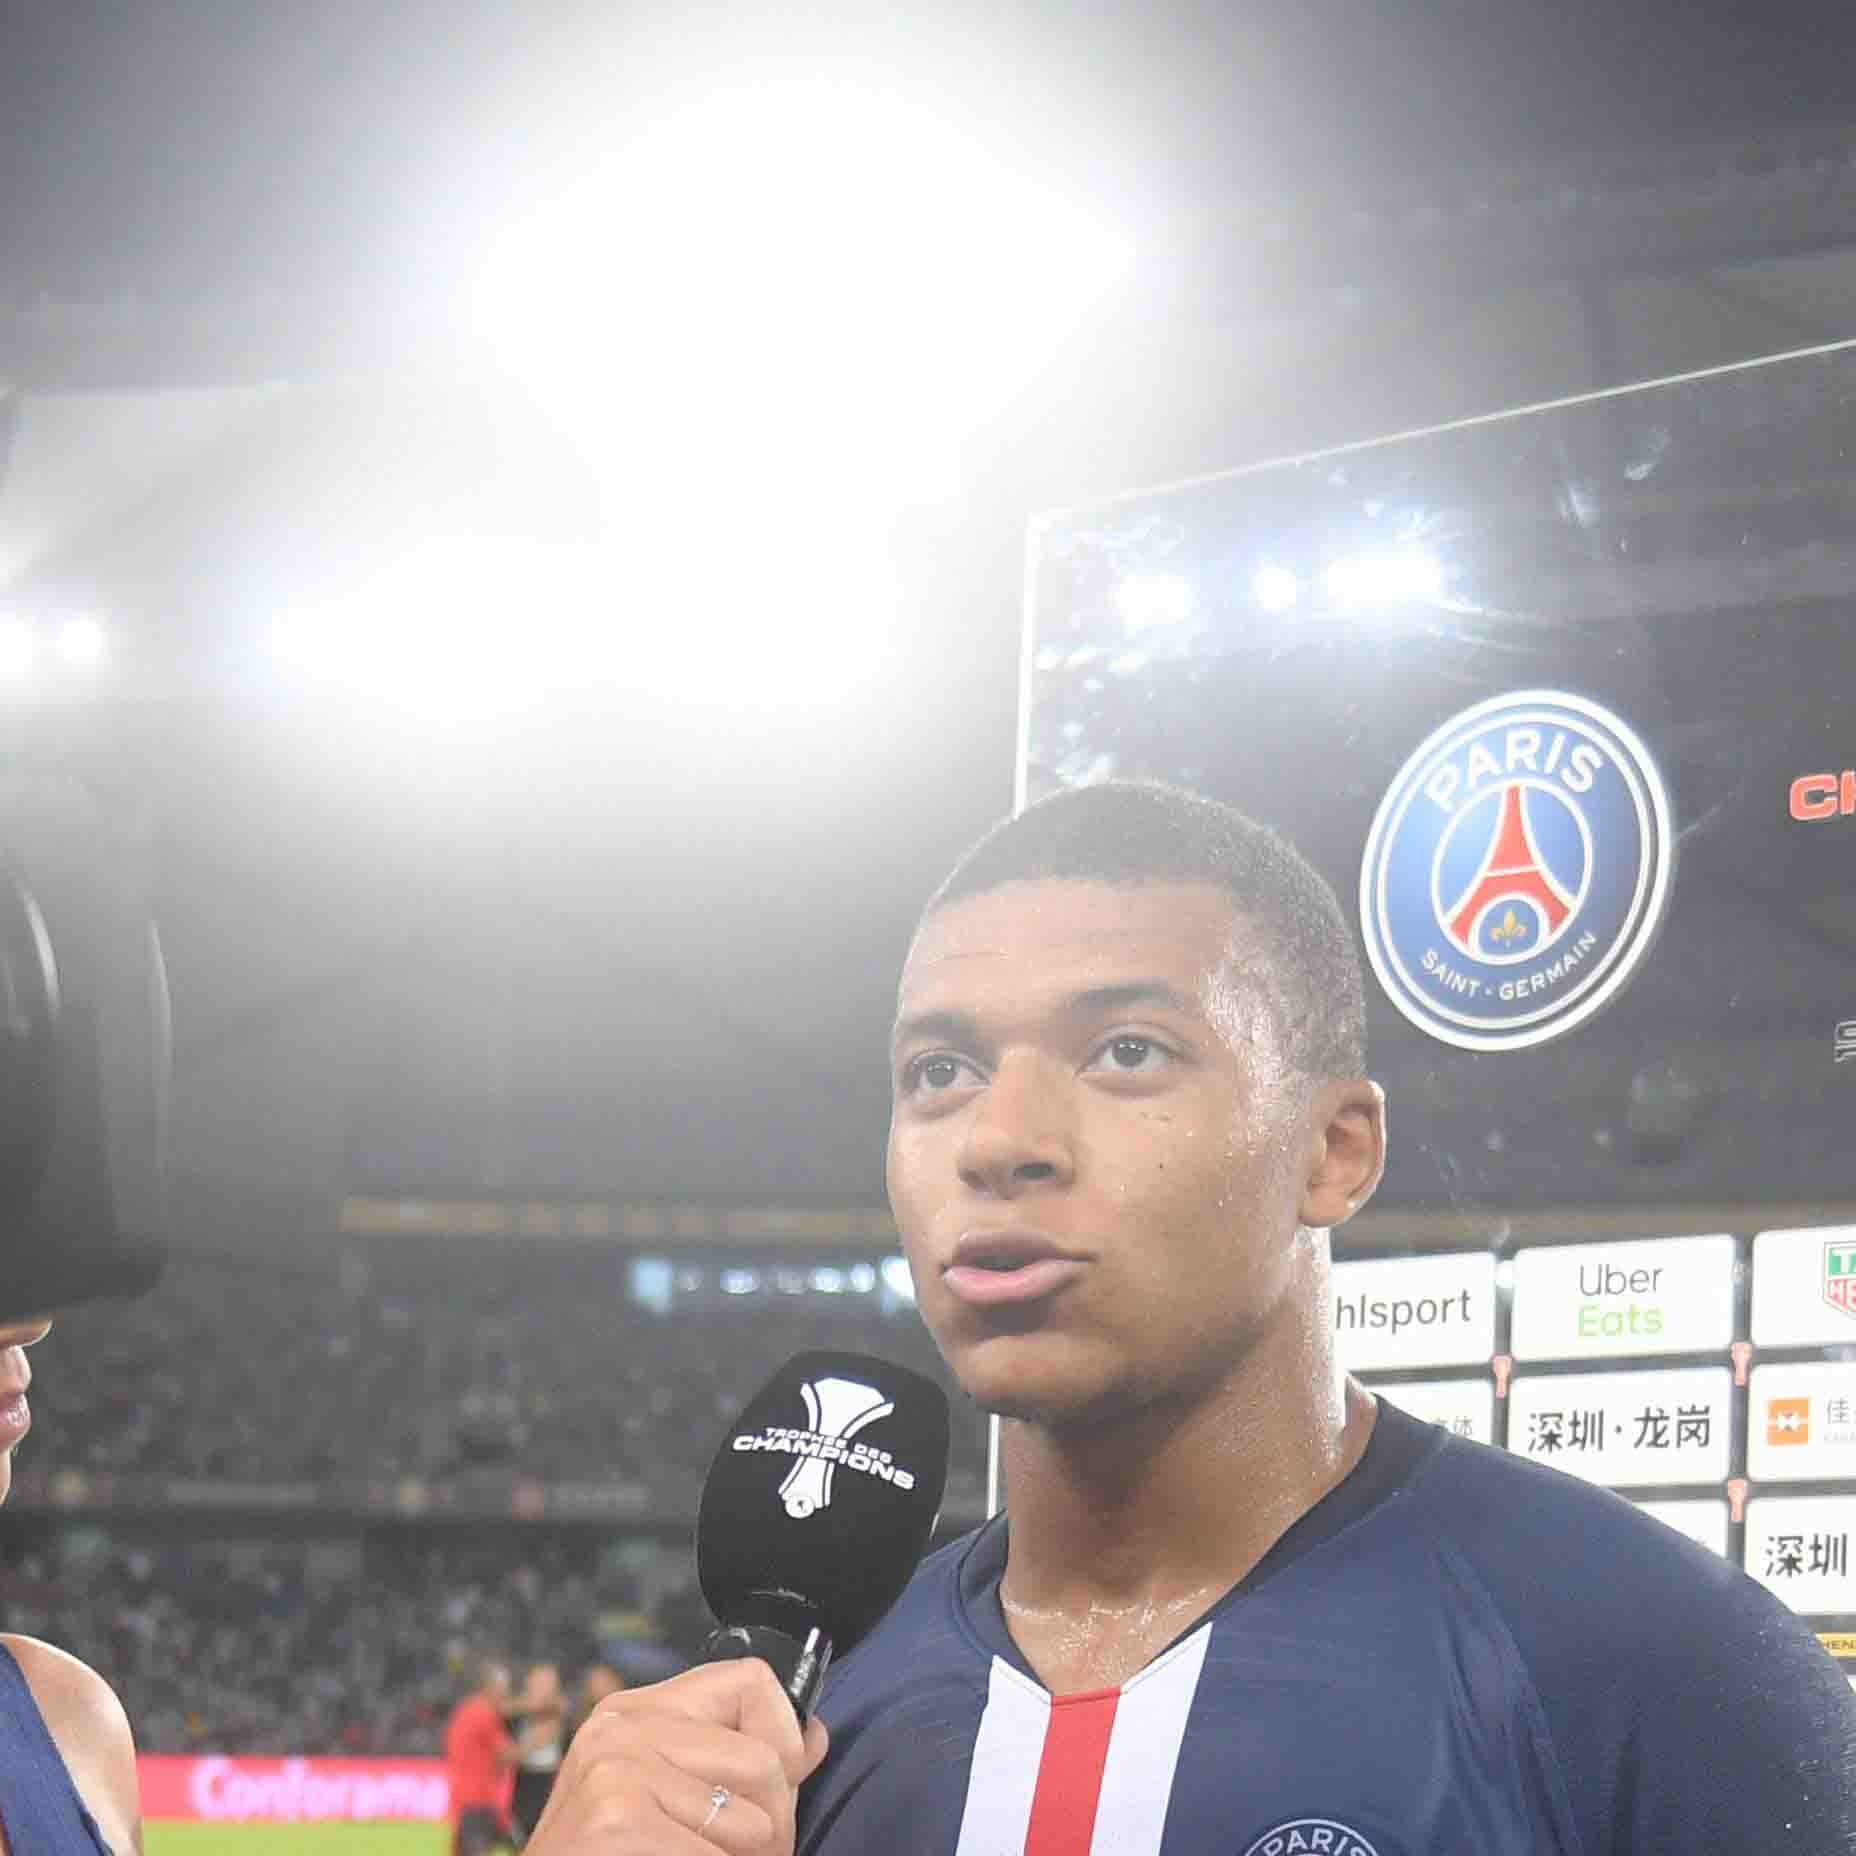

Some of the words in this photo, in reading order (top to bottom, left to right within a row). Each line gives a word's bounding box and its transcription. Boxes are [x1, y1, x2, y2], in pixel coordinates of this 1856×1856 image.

[1423, 728, 1605, 813] PARIS
[1580, 1264, 1663, 1296] Uber
[1336, 1290, 1470, 1334] hlsport
[1578, 1304, 1663, 1338] Eats
[732, 1435, 915, 1491] CHAMPIONS
